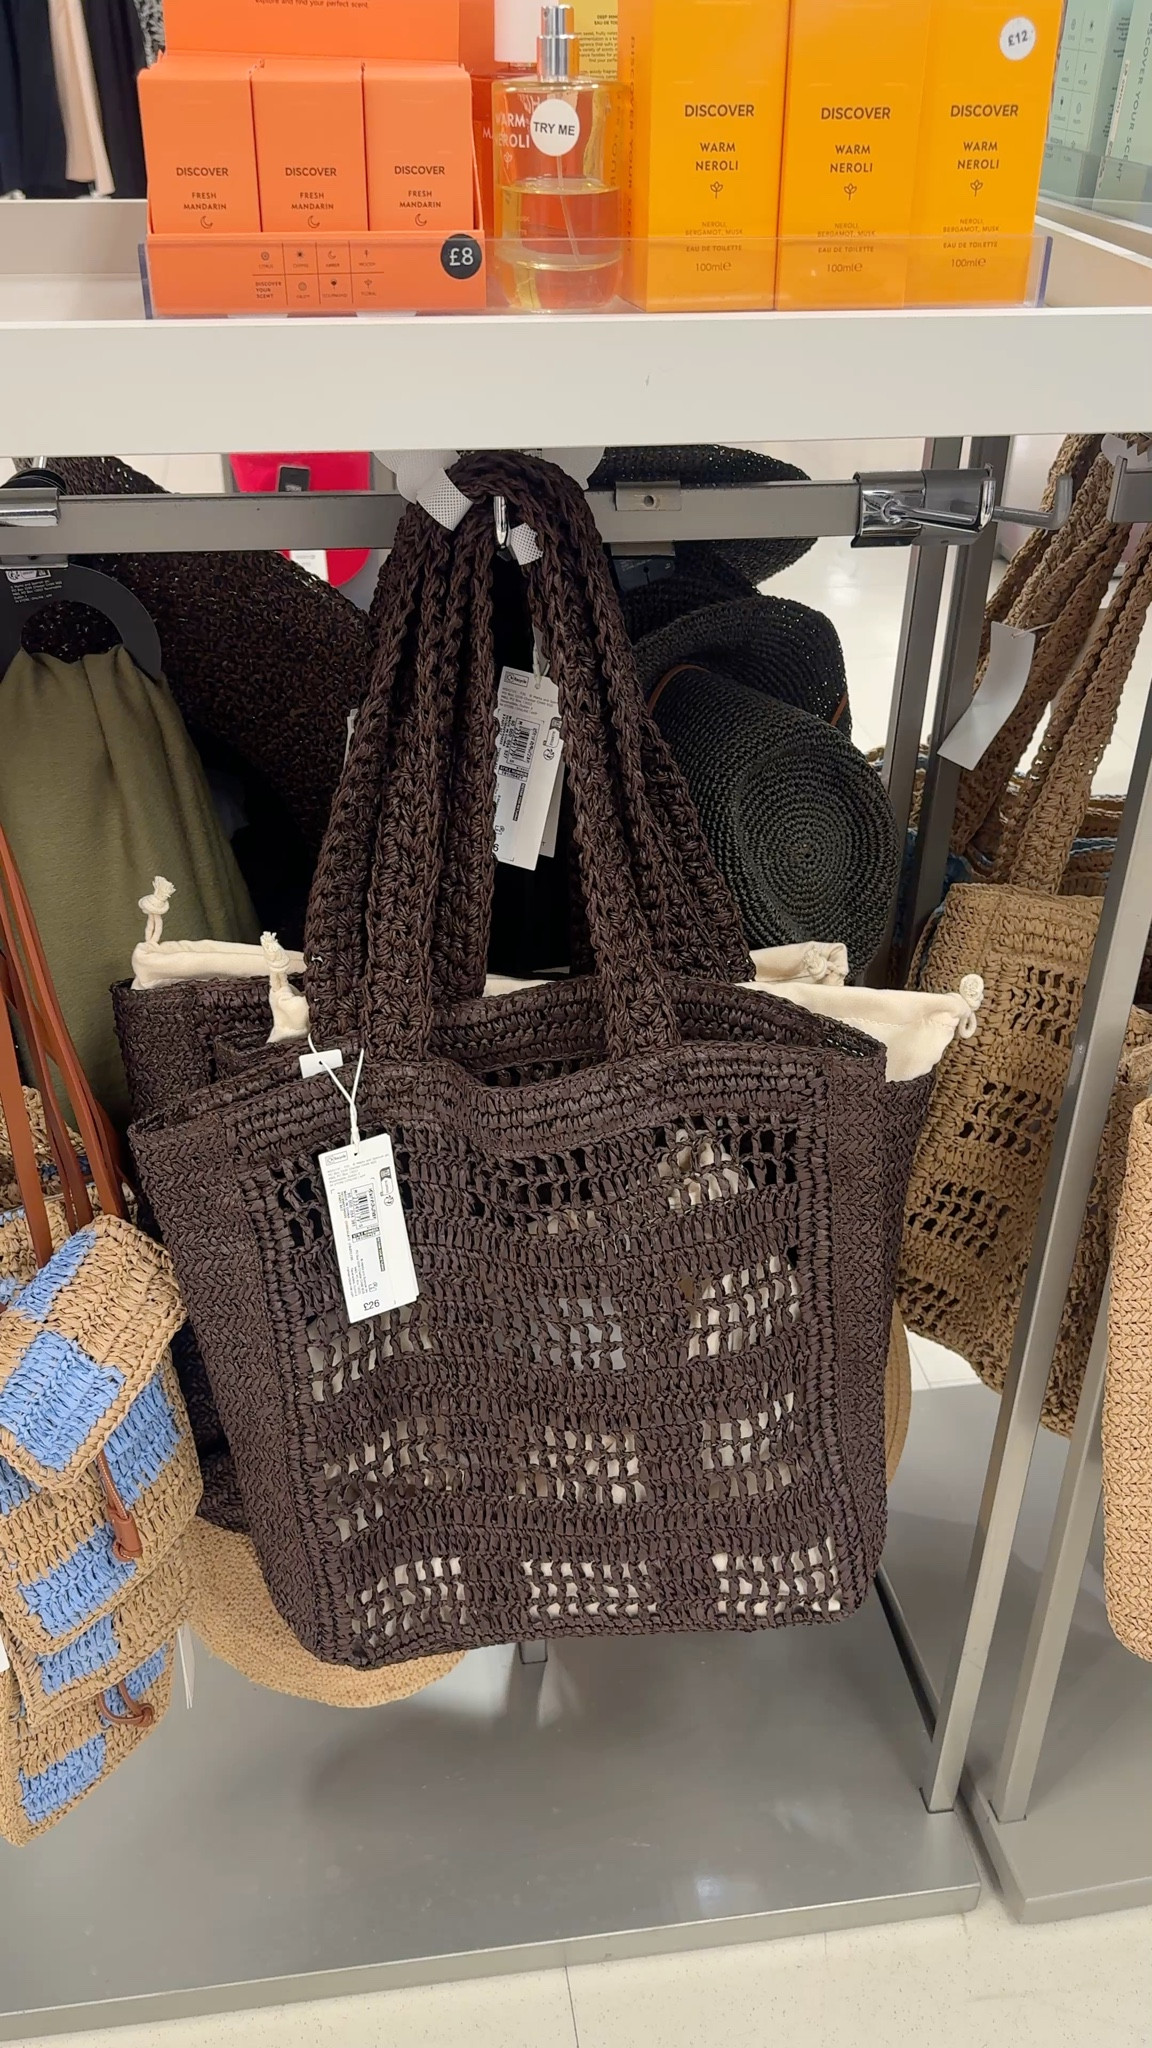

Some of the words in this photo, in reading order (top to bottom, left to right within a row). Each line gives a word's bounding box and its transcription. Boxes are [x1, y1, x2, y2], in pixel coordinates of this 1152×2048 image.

[326, 0, 349, 8] perfect
[1008, 30, 1028, 47] £12
[684, 104, 755, 117] DISCOVER
[821, 106, 891, 120] DISCOVER
[950, 104, 1019, 117] DISCOVER
[1128, 91, 1141, 131] YOUR
[533, 121, 556, 135] TRY
[558, 124, 576, 136] ME
[699, 142, 736, 152] WARM
[835, 144, 871, 154] WARM
[963, 141, 998, 151] WARM
[695, 160, 739, 171] NEROLI
[830, 162, 873, 173] NEROLI
[957, 159, 1000, 170] NEROLI
[176, 167, 229, 177] DISCOVER
[285, 167, 337, 177] DISCOVER
[394, 165, 446, 175] DISCOVER
[191, 192, 217, 200] FRESH
[299, 192, 325, 200] FRESH
[408, 190, 433, 198] FRESH
[713, 244, 742, 252] TOILETTE
[449, 247, 474, 266] £8
[363, 1299, 380, 1311] £26
